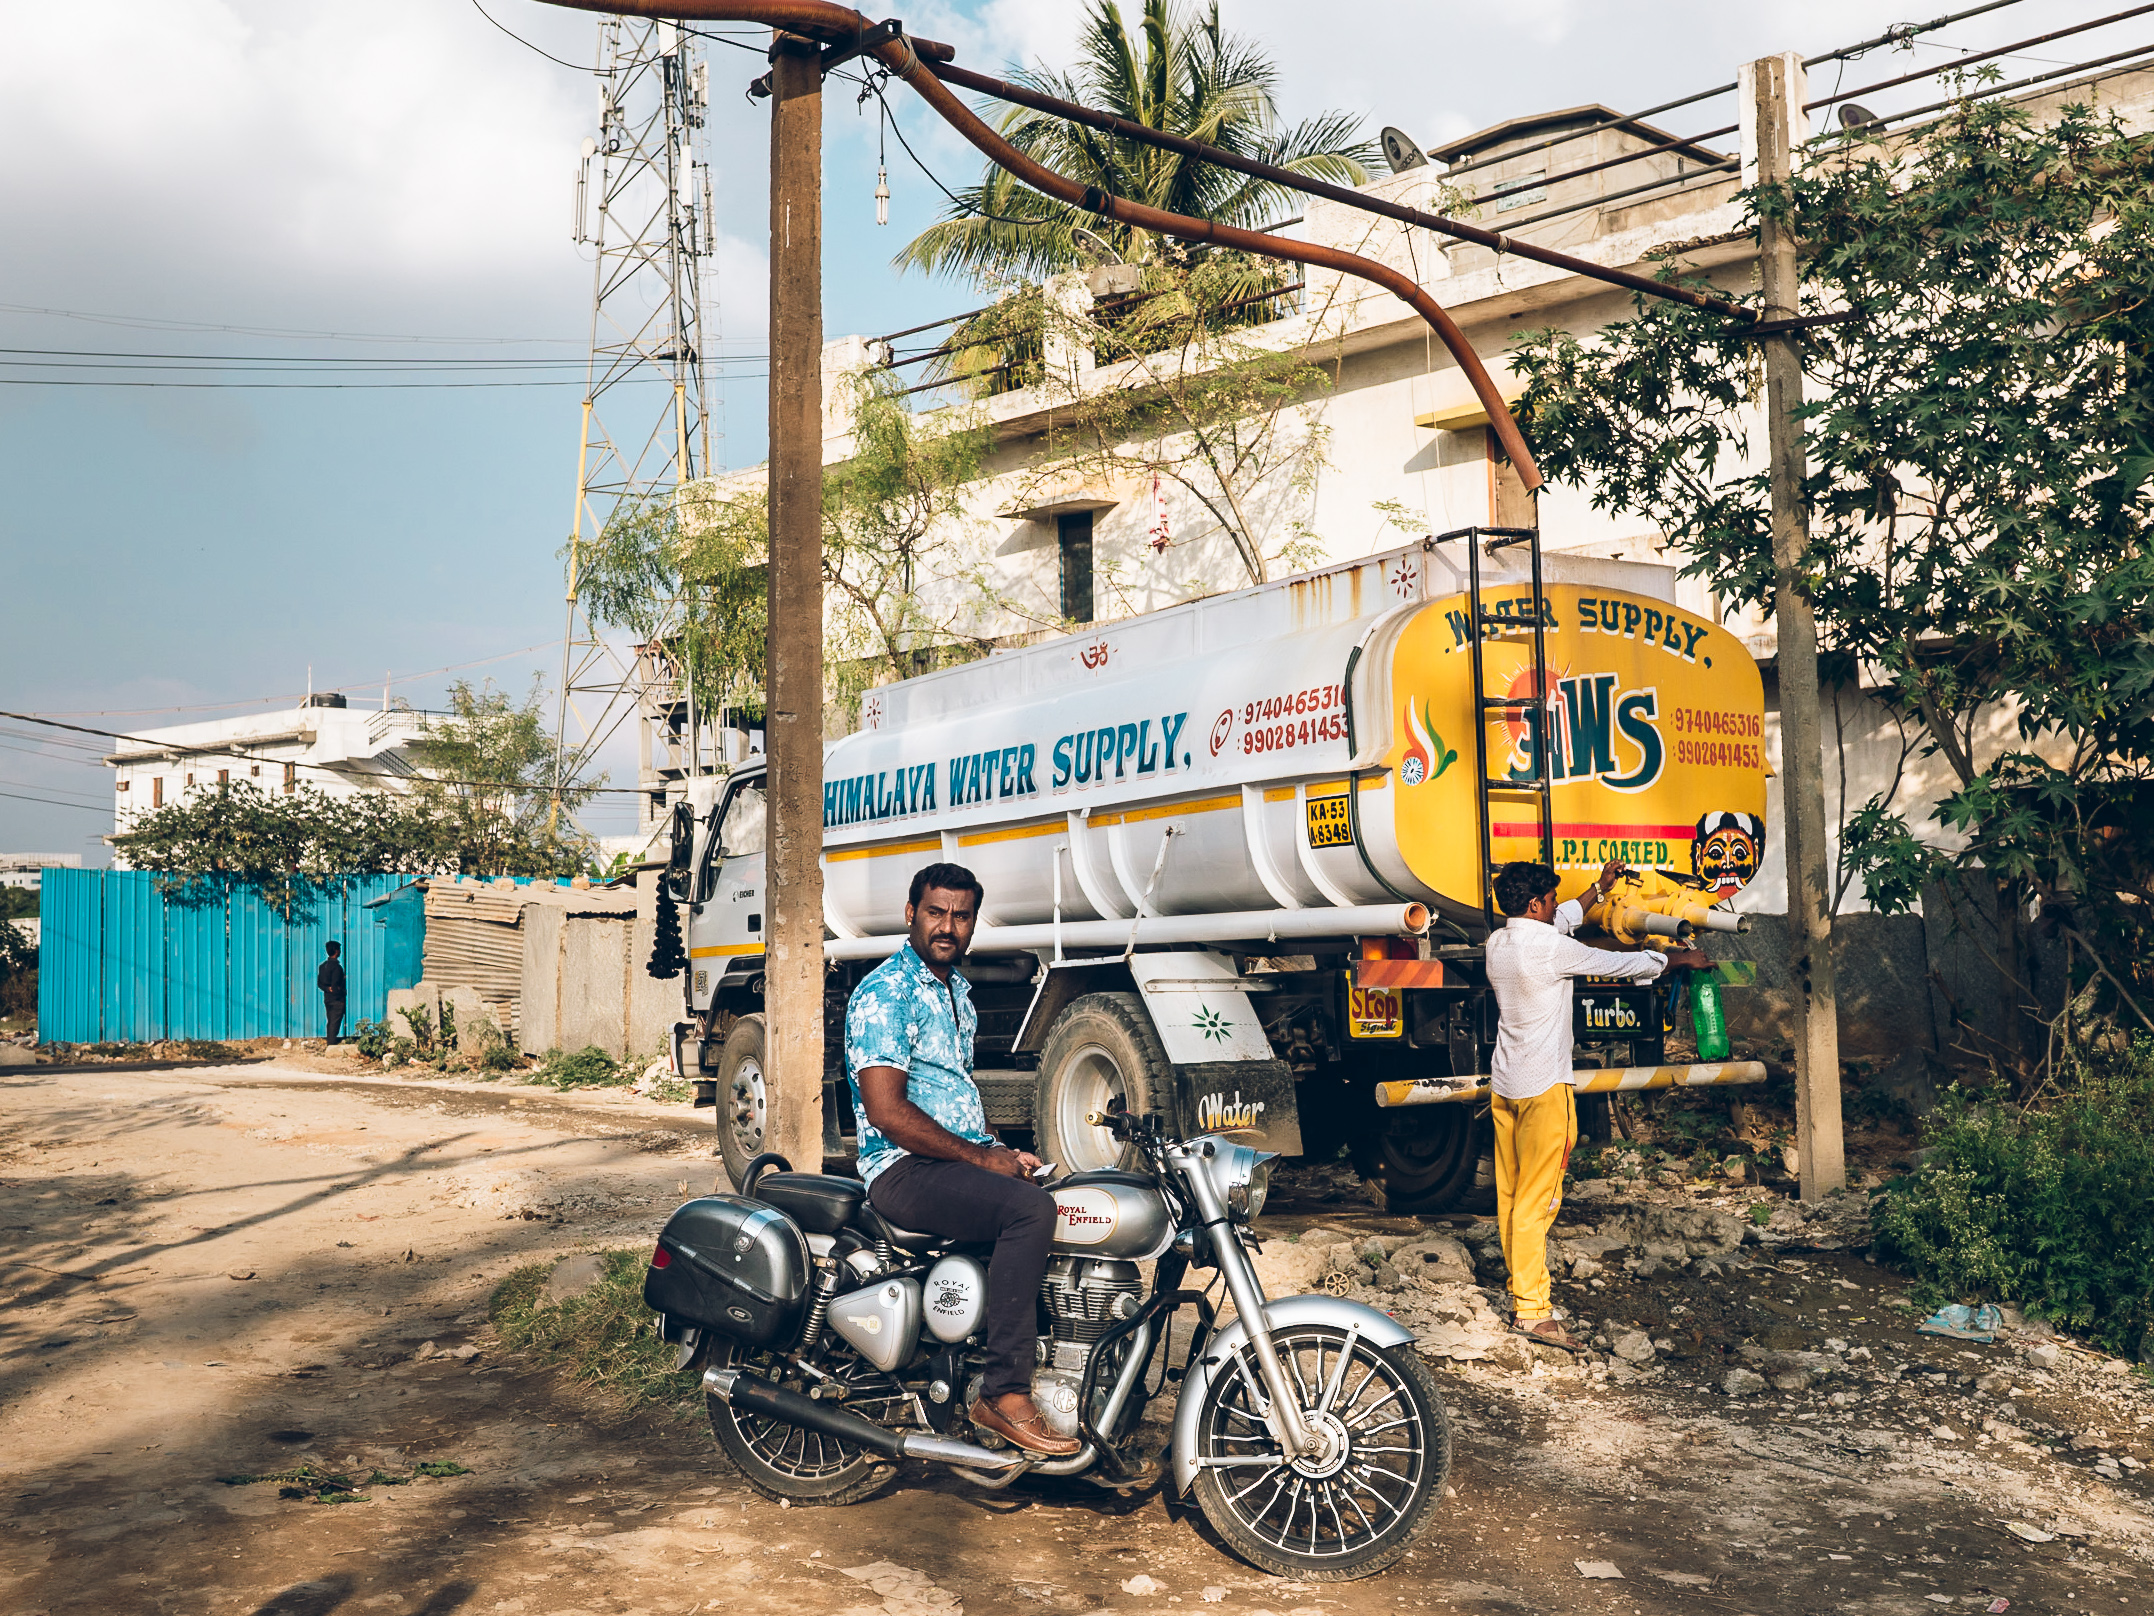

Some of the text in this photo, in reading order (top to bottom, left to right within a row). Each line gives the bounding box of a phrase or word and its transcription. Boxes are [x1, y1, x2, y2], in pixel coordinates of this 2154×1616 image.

[823, 712, 1191, 828] HIMALAYA WATER SUPPLY,
[1352, 988, 1399, 1028] Stop
[1582, 997, 1641, 1028] Turbo.
[1198, 1090, 1265, 1129] Water
[1057, 1205, 1087, 1216] ROYAL
[1069, 1214, 1112, 1226] ENFIELD
[933, 1306, 965, 1316] ENFIELD
